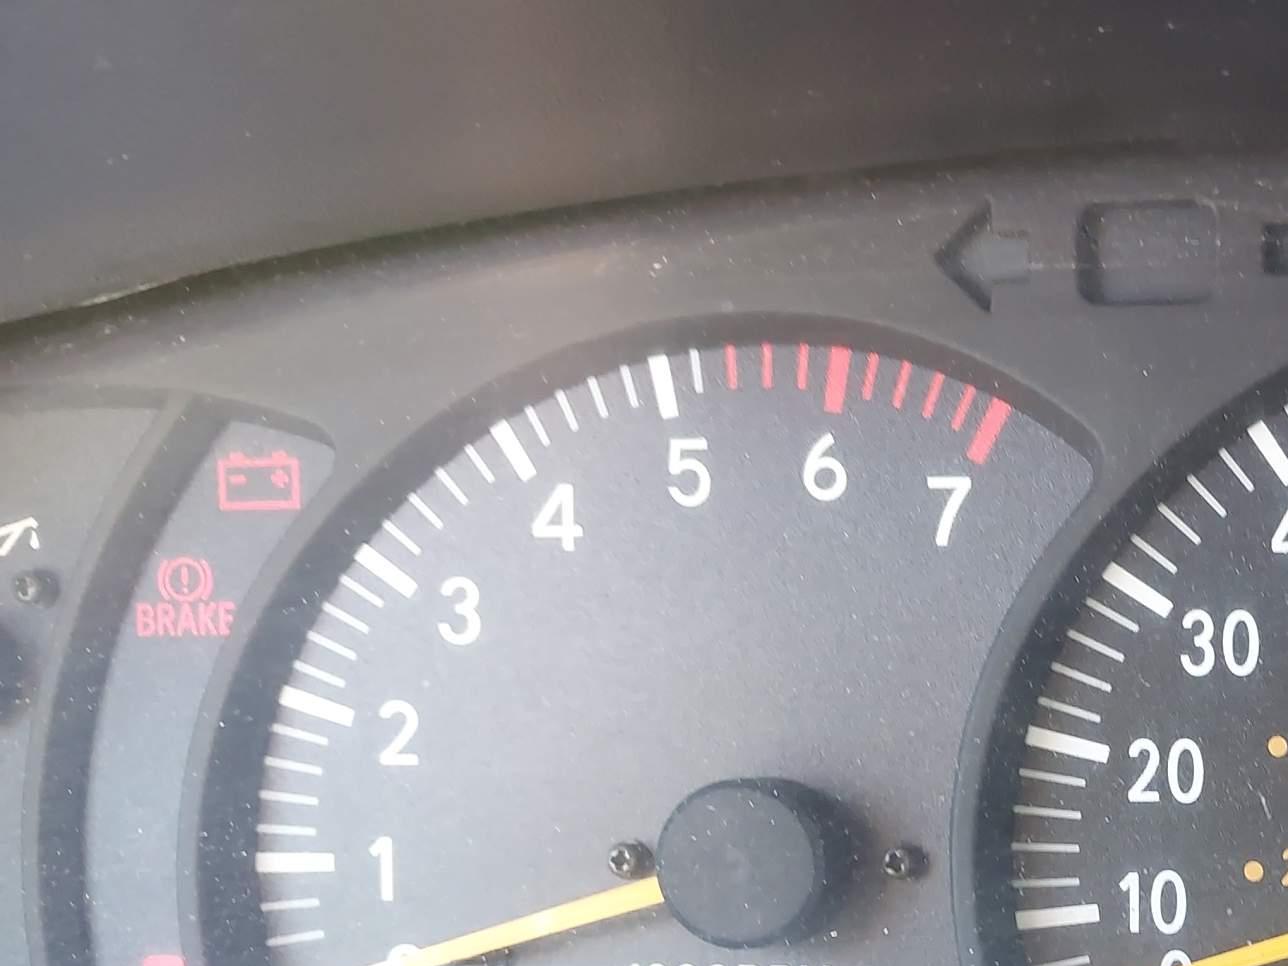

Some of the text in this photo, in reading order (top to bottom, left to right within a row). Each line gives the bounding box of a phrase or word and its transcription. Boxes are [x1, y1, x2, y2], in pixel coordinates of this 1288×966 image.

[667, 438, 710, 507] 5
[803, 432, 847, 501] 6
[532, 483, 583, 551] 4
[927, 476, 971, 546] 7
[136, 602, 235, 637] BRAKE
[437, 576, 481, 646] 3
[1180, 608, 1260, 677] 30
[379, 700, 419, 765] 2
[1127, 738, 1204, 804] 20
[369, 836, 394, 901] 1
[1118, 869, 1187, 934] 10
